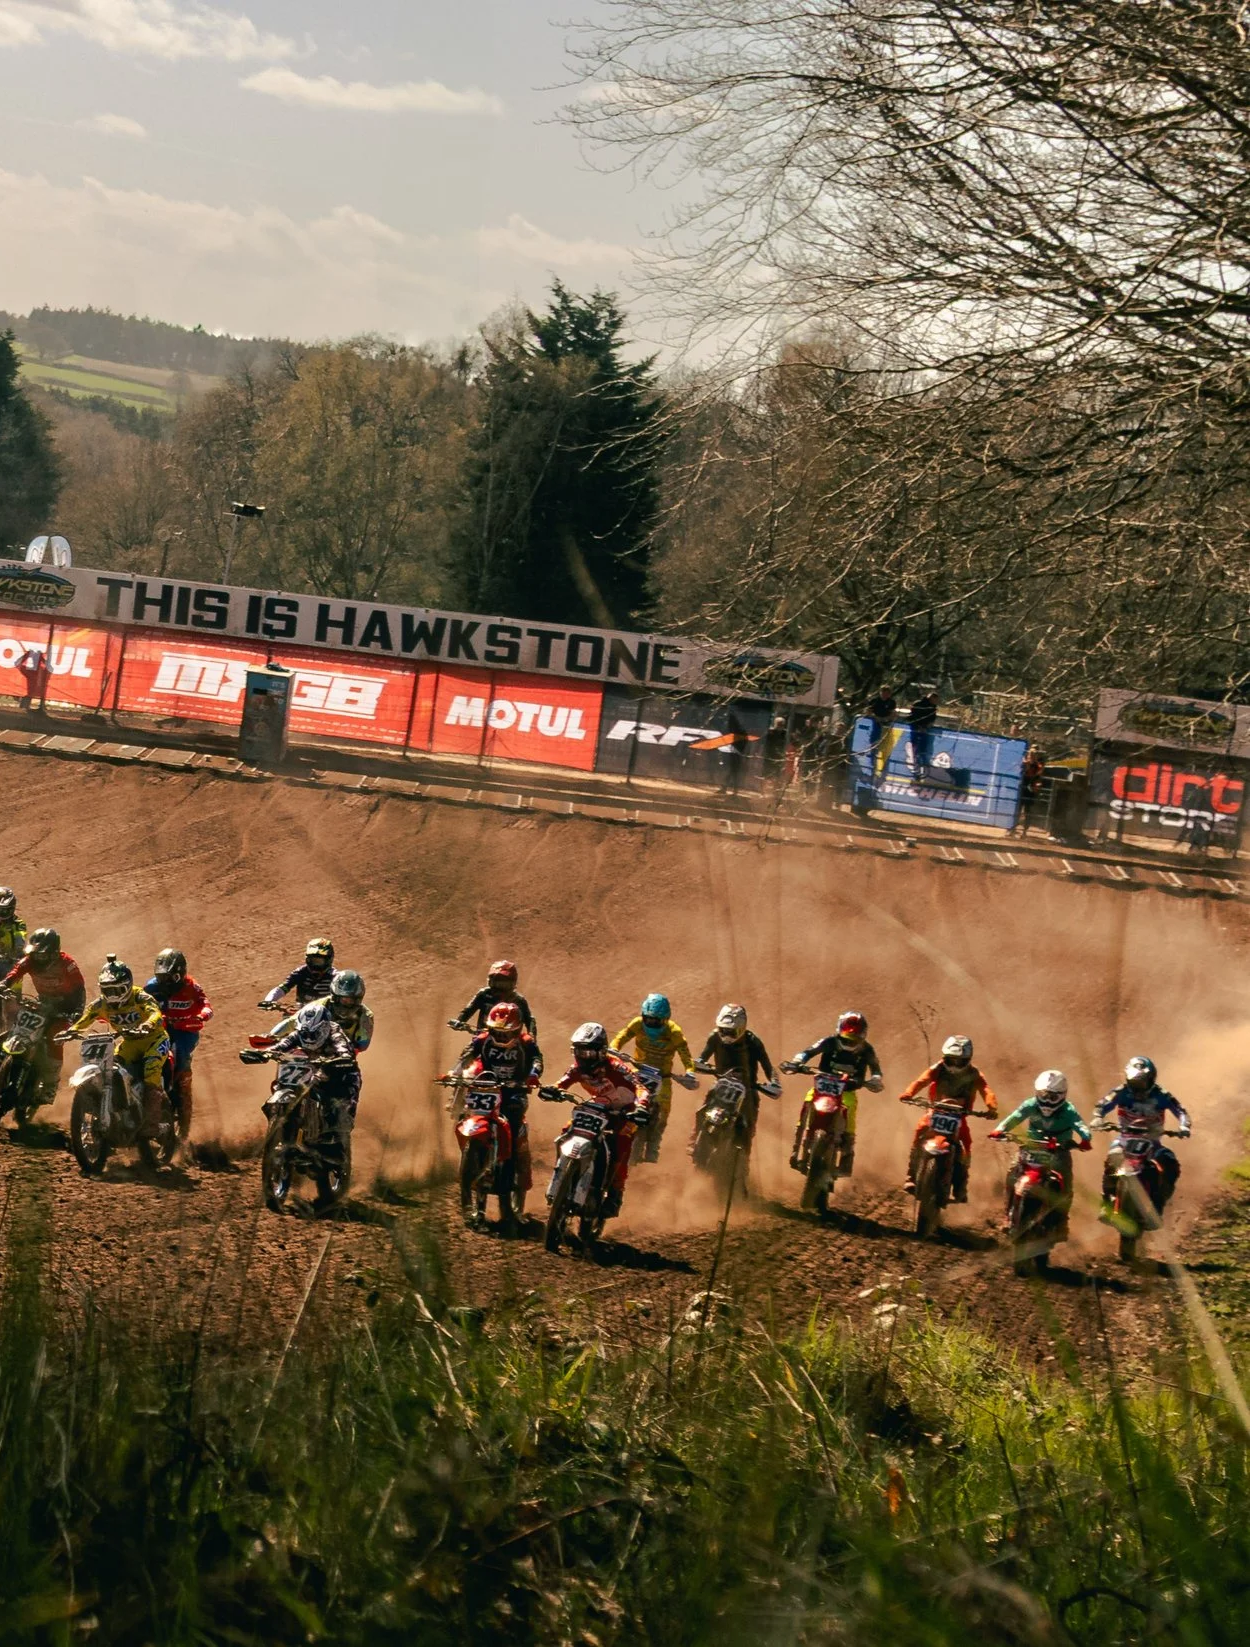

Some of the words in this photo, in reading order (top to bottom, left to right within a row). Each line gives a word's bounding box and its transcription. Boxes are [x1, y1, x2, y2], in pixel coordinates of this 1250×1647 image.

[97, 577, 231, 630] THIS
[246, 595, 299, 639] IS
[316, 603, 683, 685] HAWKSTONE
[445, 695, 586, 740] MOTUL
[877, 783, 983, 807] MICHELIN
[1112, 763, 1244, 814] dirt
[1108, 799, 1238, 835] STORE
[81, 1044, 107, 1060] 41
[488, 1048, 518, 1060] FXR
[468, 1092, 498, 1111] 33
[572, 1112, 601, 1132] 228
[932, 1116, 959, 1133] 190
